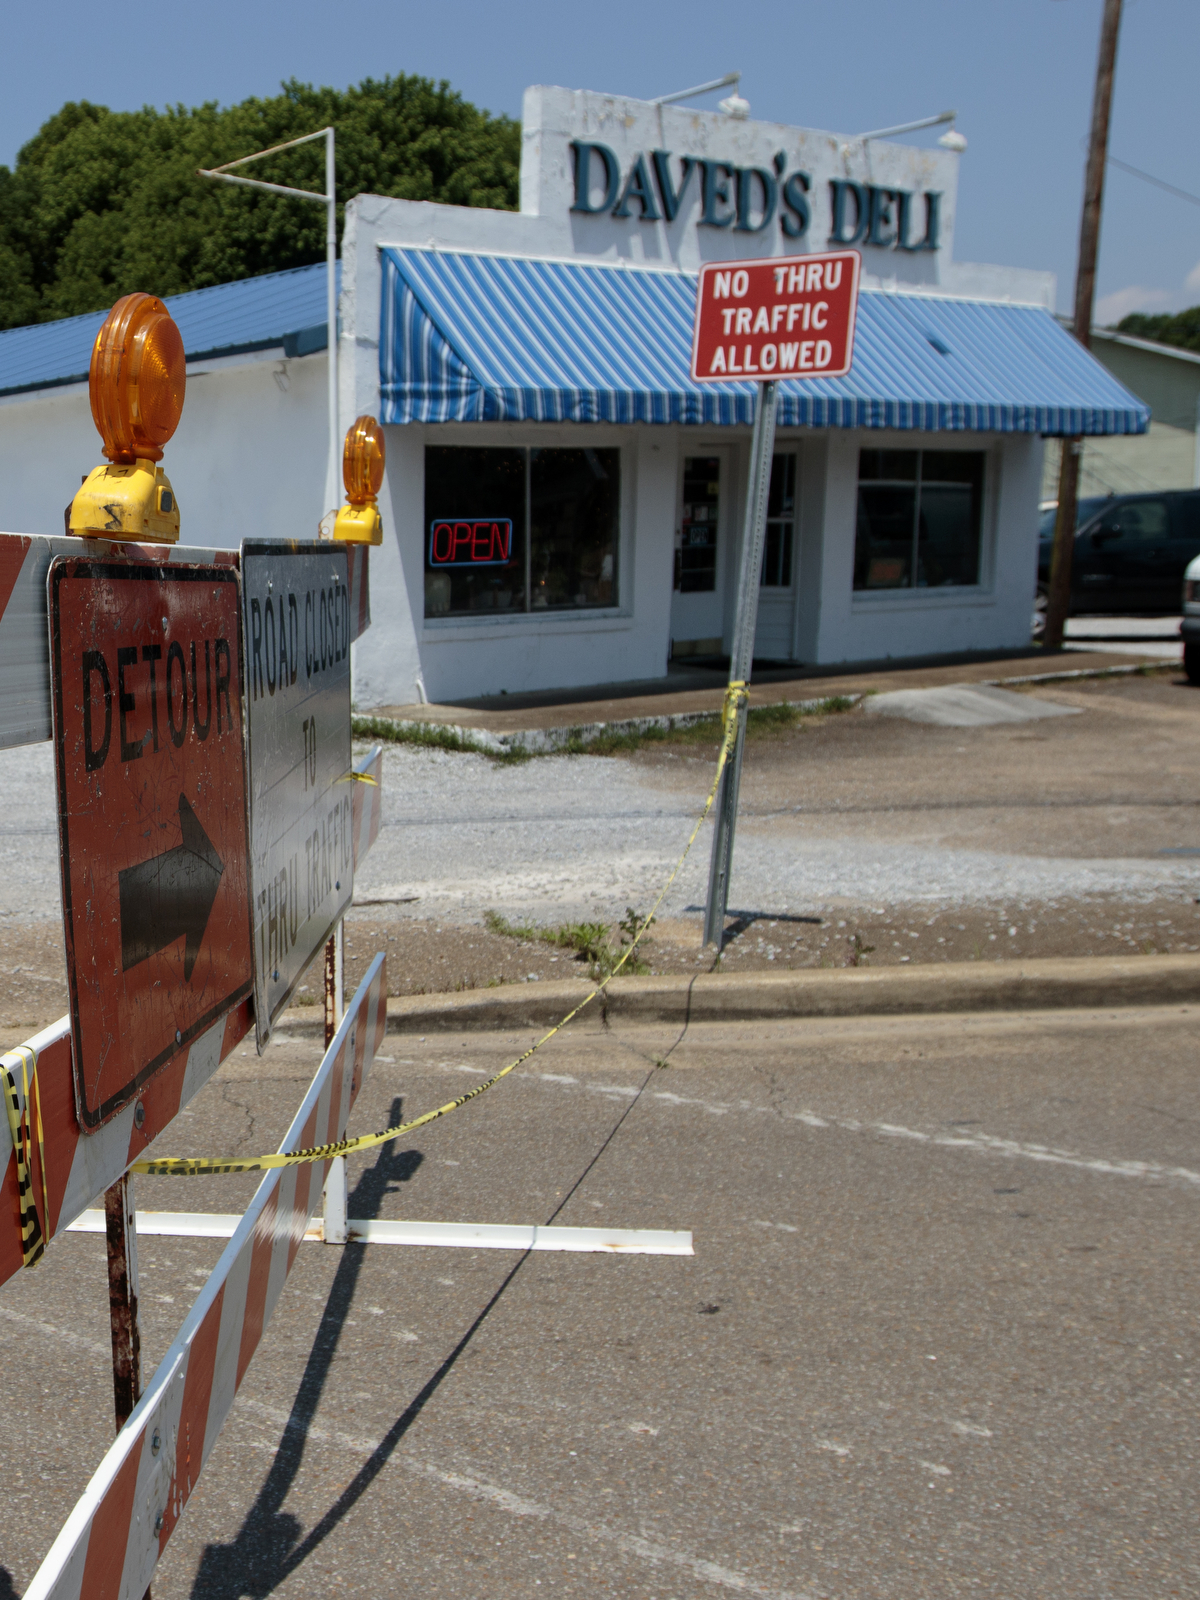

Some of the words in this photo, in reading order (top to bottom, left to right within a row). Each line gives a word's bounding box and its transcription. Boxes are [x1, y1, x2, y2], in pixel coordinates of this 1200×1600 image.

[569, 139, 812, 239] DAVED'S
[828, 178, 943, 252] DELI
[713, 269, 750, 300] NO
[773, 261, 843, 295] THRU
[721, 301, 829, 336] TRAFFIC
[709, 339, 832, 374] ALLOWED
[432, 522, 510, 562] OPEN
[251, 593, 298, 701] ROAD
[305, 584, 349, 680] CLOSED
[82, 638, 233, 773] DETOUR
[303, 715, 317, 792] TO
[257, 852, 299, 988] THRU
[305, 794, 350, 922] TRAFFIC
